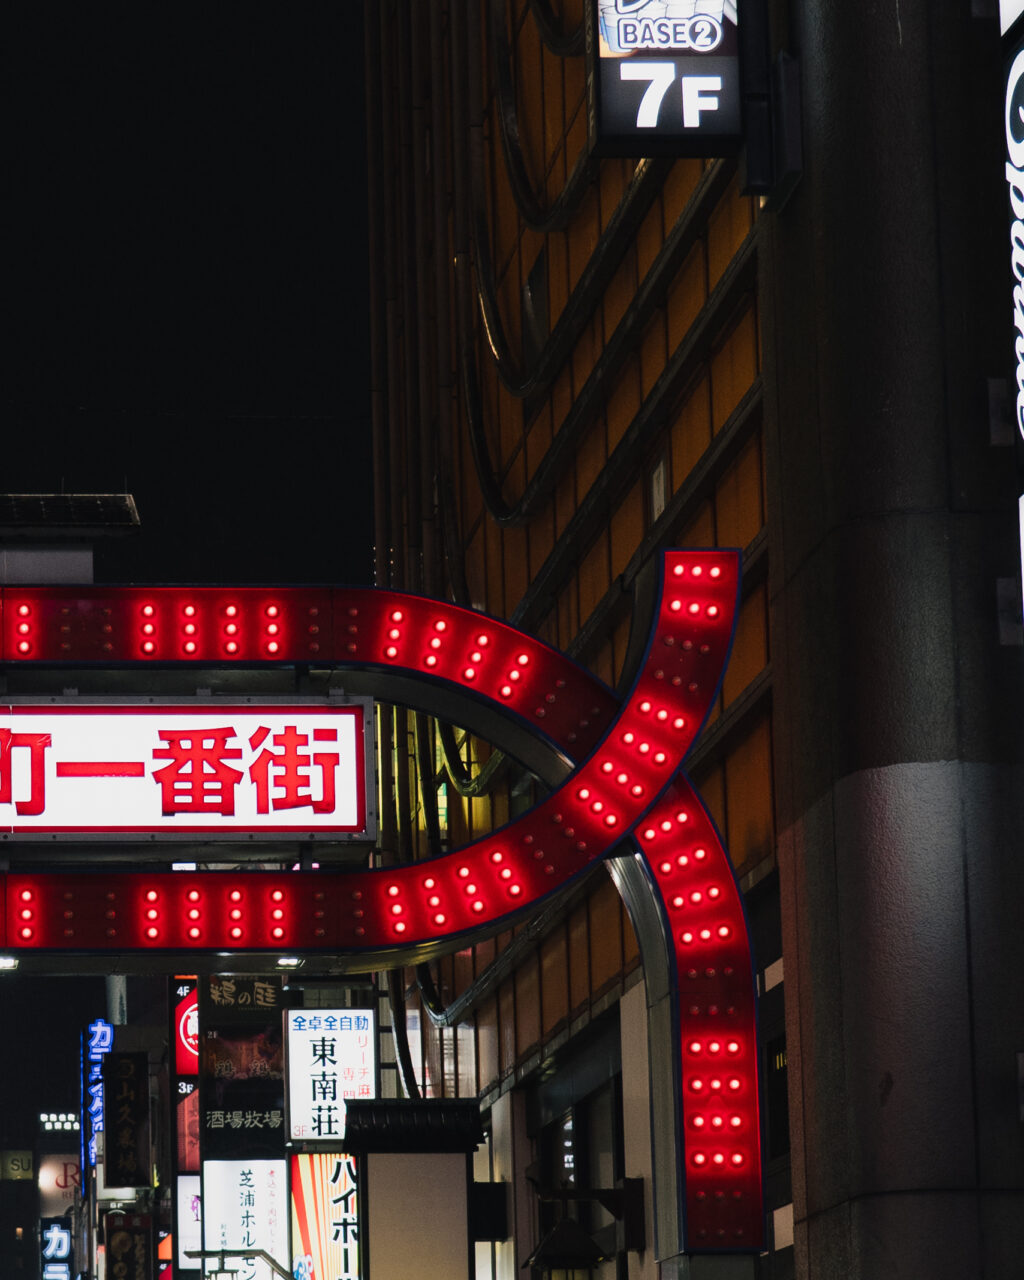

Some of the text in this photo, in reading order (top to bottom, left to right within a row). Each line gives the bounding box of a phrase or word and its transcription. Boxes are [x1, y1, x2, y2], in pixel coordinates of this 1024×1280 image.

[621, 22, 687, 46] BASE
[620, 62, 722, 128] 7F
[176, 985, 191, 997] 4F
[292, 1015, 370, 1032] 全卓全自動
[178, 1081, 194, 1094] 3F
[309, 1036, 339, 1137] 東南荘
[293, 1125, 307, 1137] 3F
